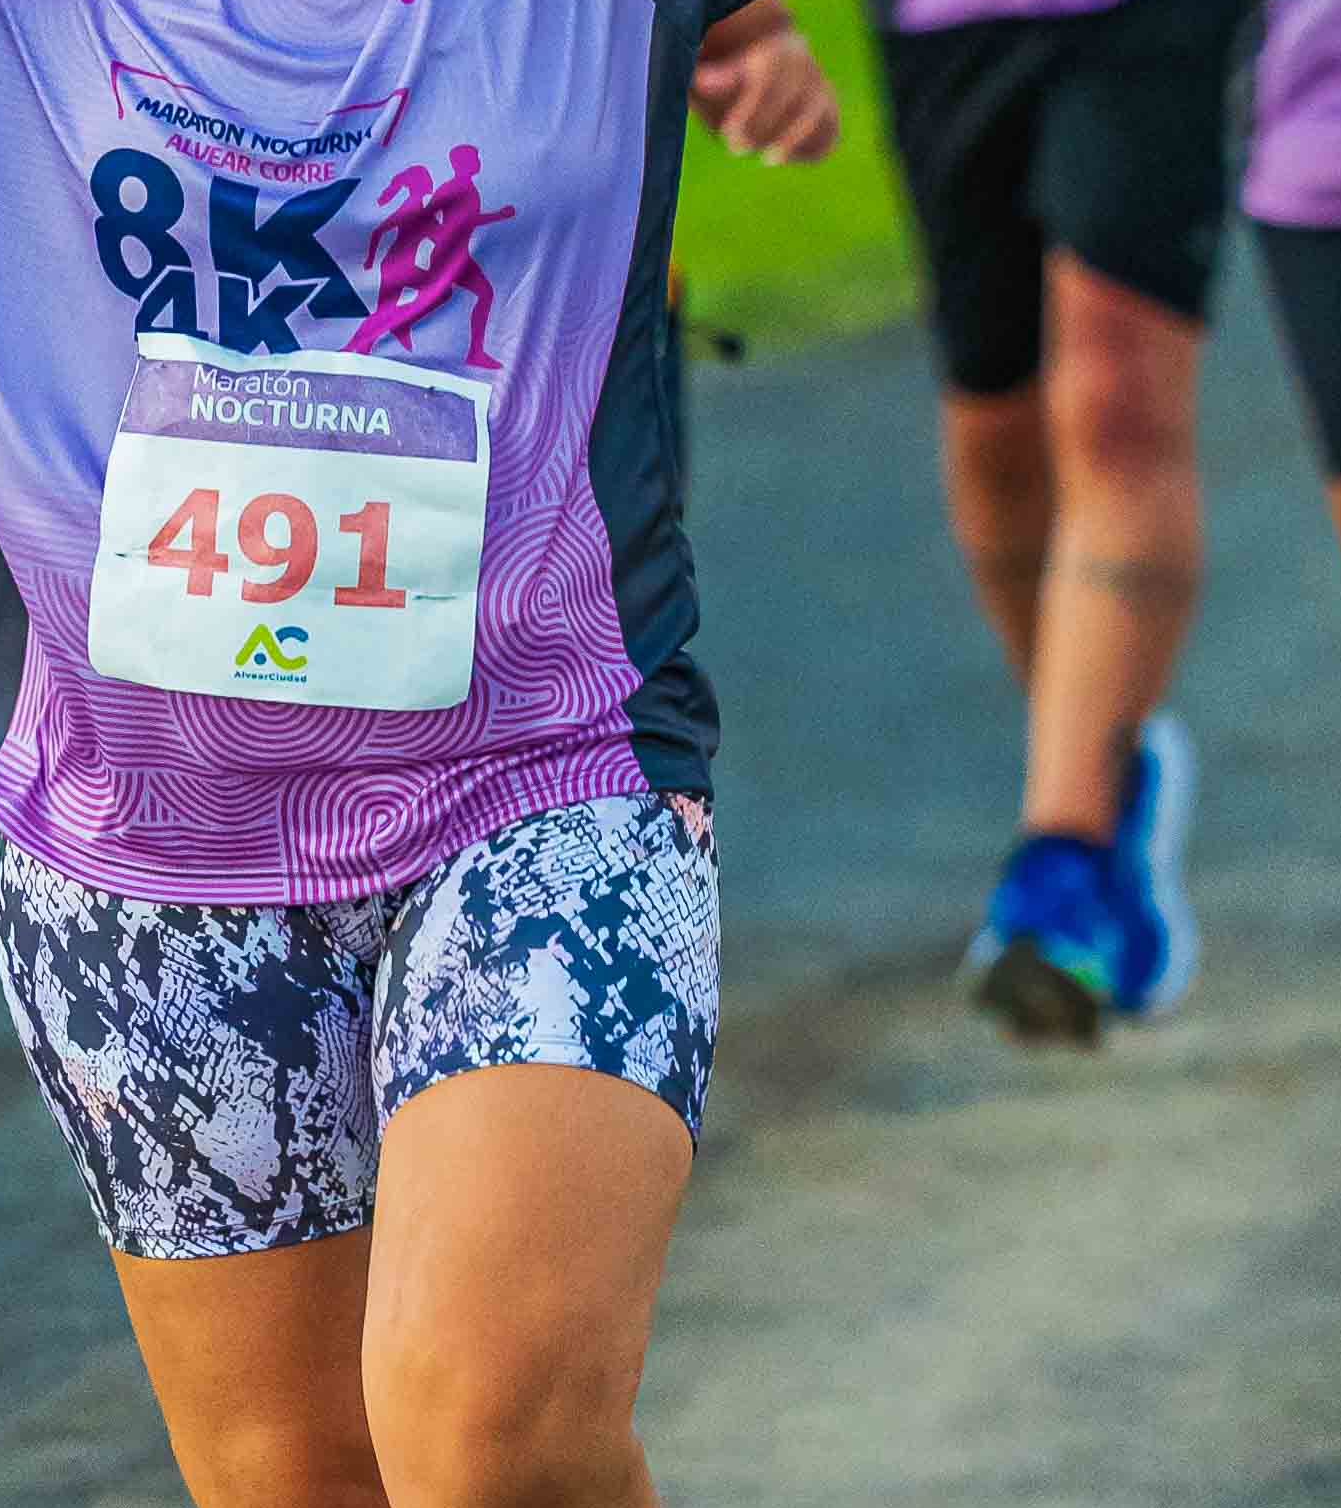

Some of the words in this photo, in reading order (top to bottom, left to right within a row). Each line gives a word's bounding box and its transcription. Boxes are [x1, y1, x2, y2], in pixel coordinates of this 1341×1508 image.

[135, 96, 246, 147] MARATON
[165, 133, 251, 176] ALVEAR
[260, 161, 336, 184] CORRE
[90, 148, 373, 320] 8K
[193, 364, 310, 399] Maratón
[189, 392, 391, 436] NOCTURNA
[147, 487, 407, 609] 491
